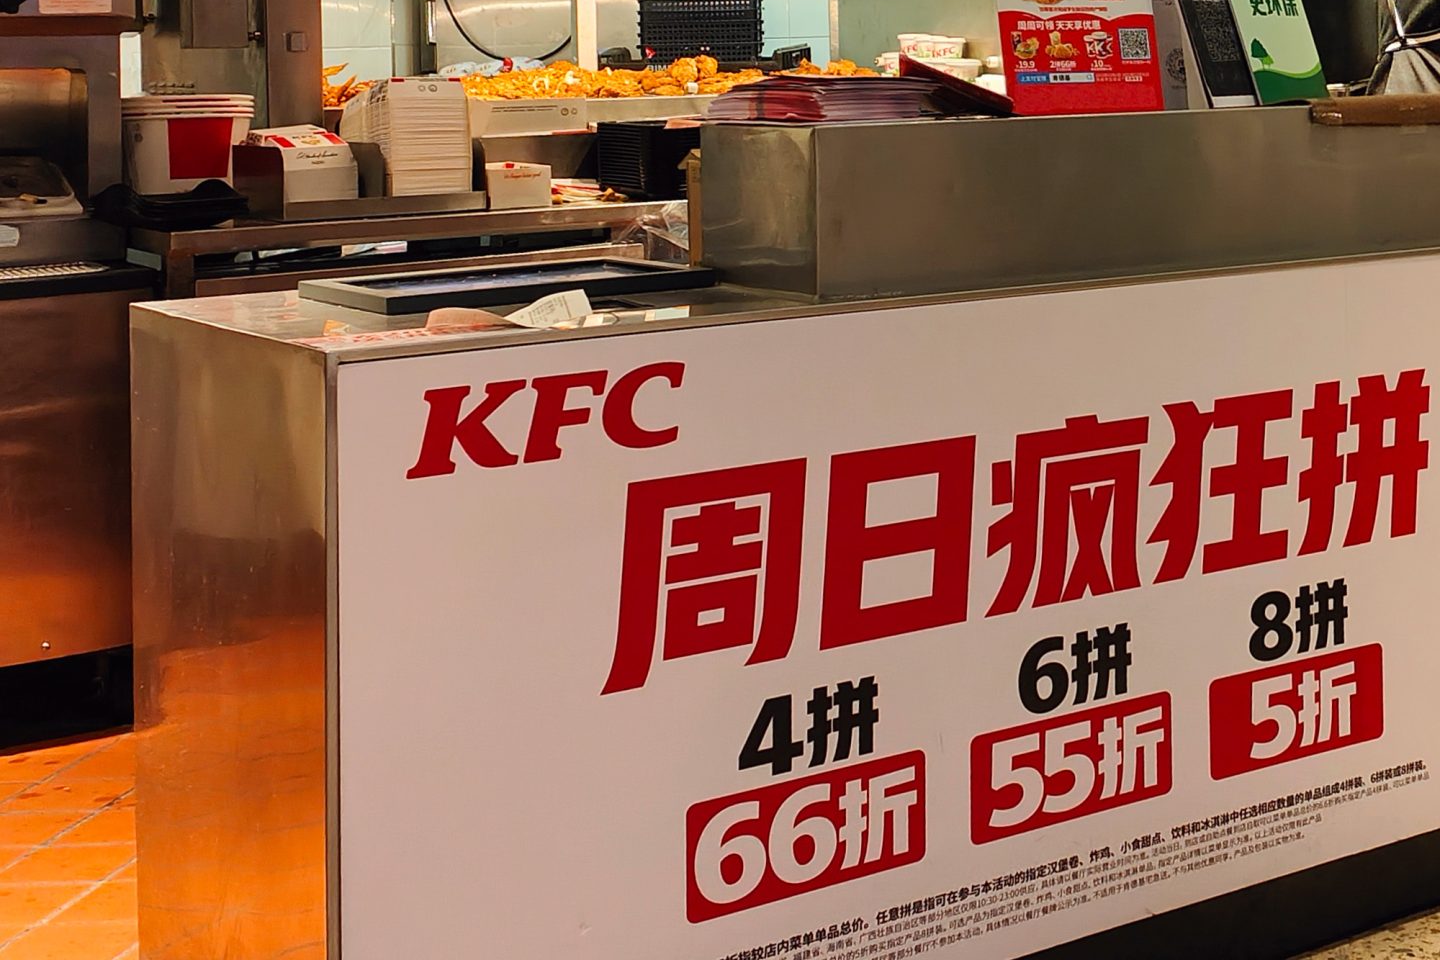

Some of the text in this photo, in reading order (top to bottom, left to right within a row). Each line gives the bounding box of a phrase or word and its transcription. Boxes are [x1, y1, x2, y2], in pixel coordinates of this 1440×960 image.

[407, 362, 685, 480] KFC
[600, 368, 1431, 696] 周日疯狂拼
[1018, 622, 1132, 714] 6拼
[1248, 578, 1348, 662] 8拼
[737, 676, 879, 776] 4拼
[1249, 661, 1358, 760] 5折
[990, 706, 1166, 828] 55折
[693, 752, 919, 906] 66折
